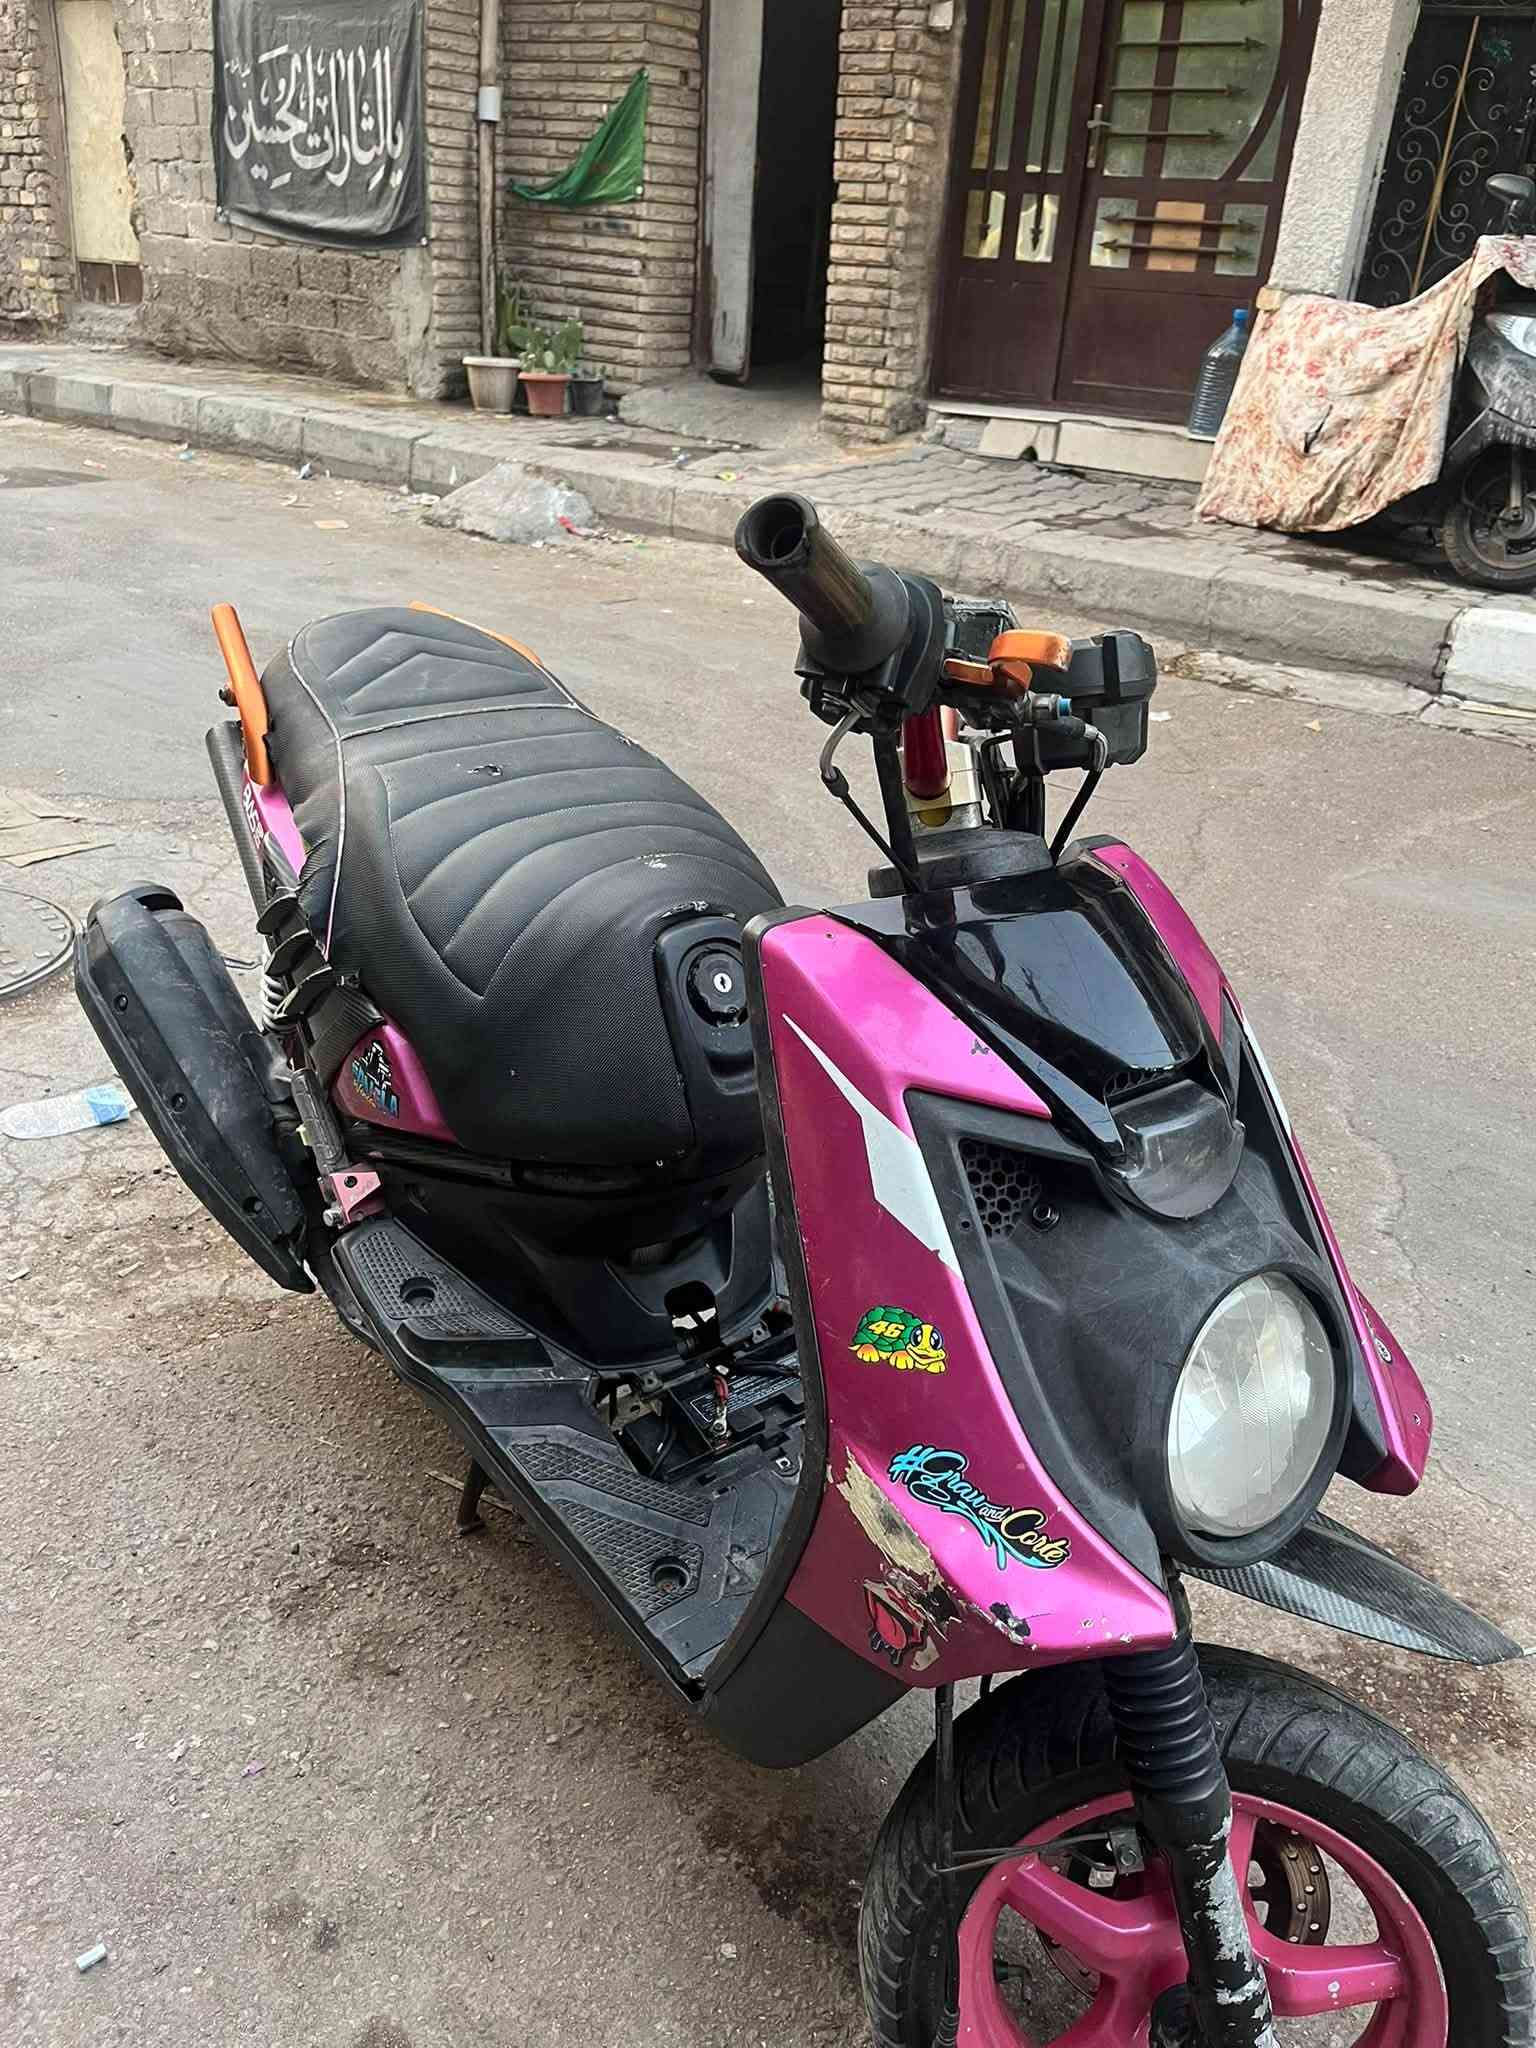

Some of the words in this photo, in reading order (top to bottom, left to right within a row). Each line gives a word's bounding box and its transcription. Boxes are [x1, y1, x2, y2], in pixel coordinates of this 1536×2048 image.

[867, 1320, 906, 1339] 46
[979, 1504, 1012, 1525] and
[1001, 1508, 1070, 1563] Corte
